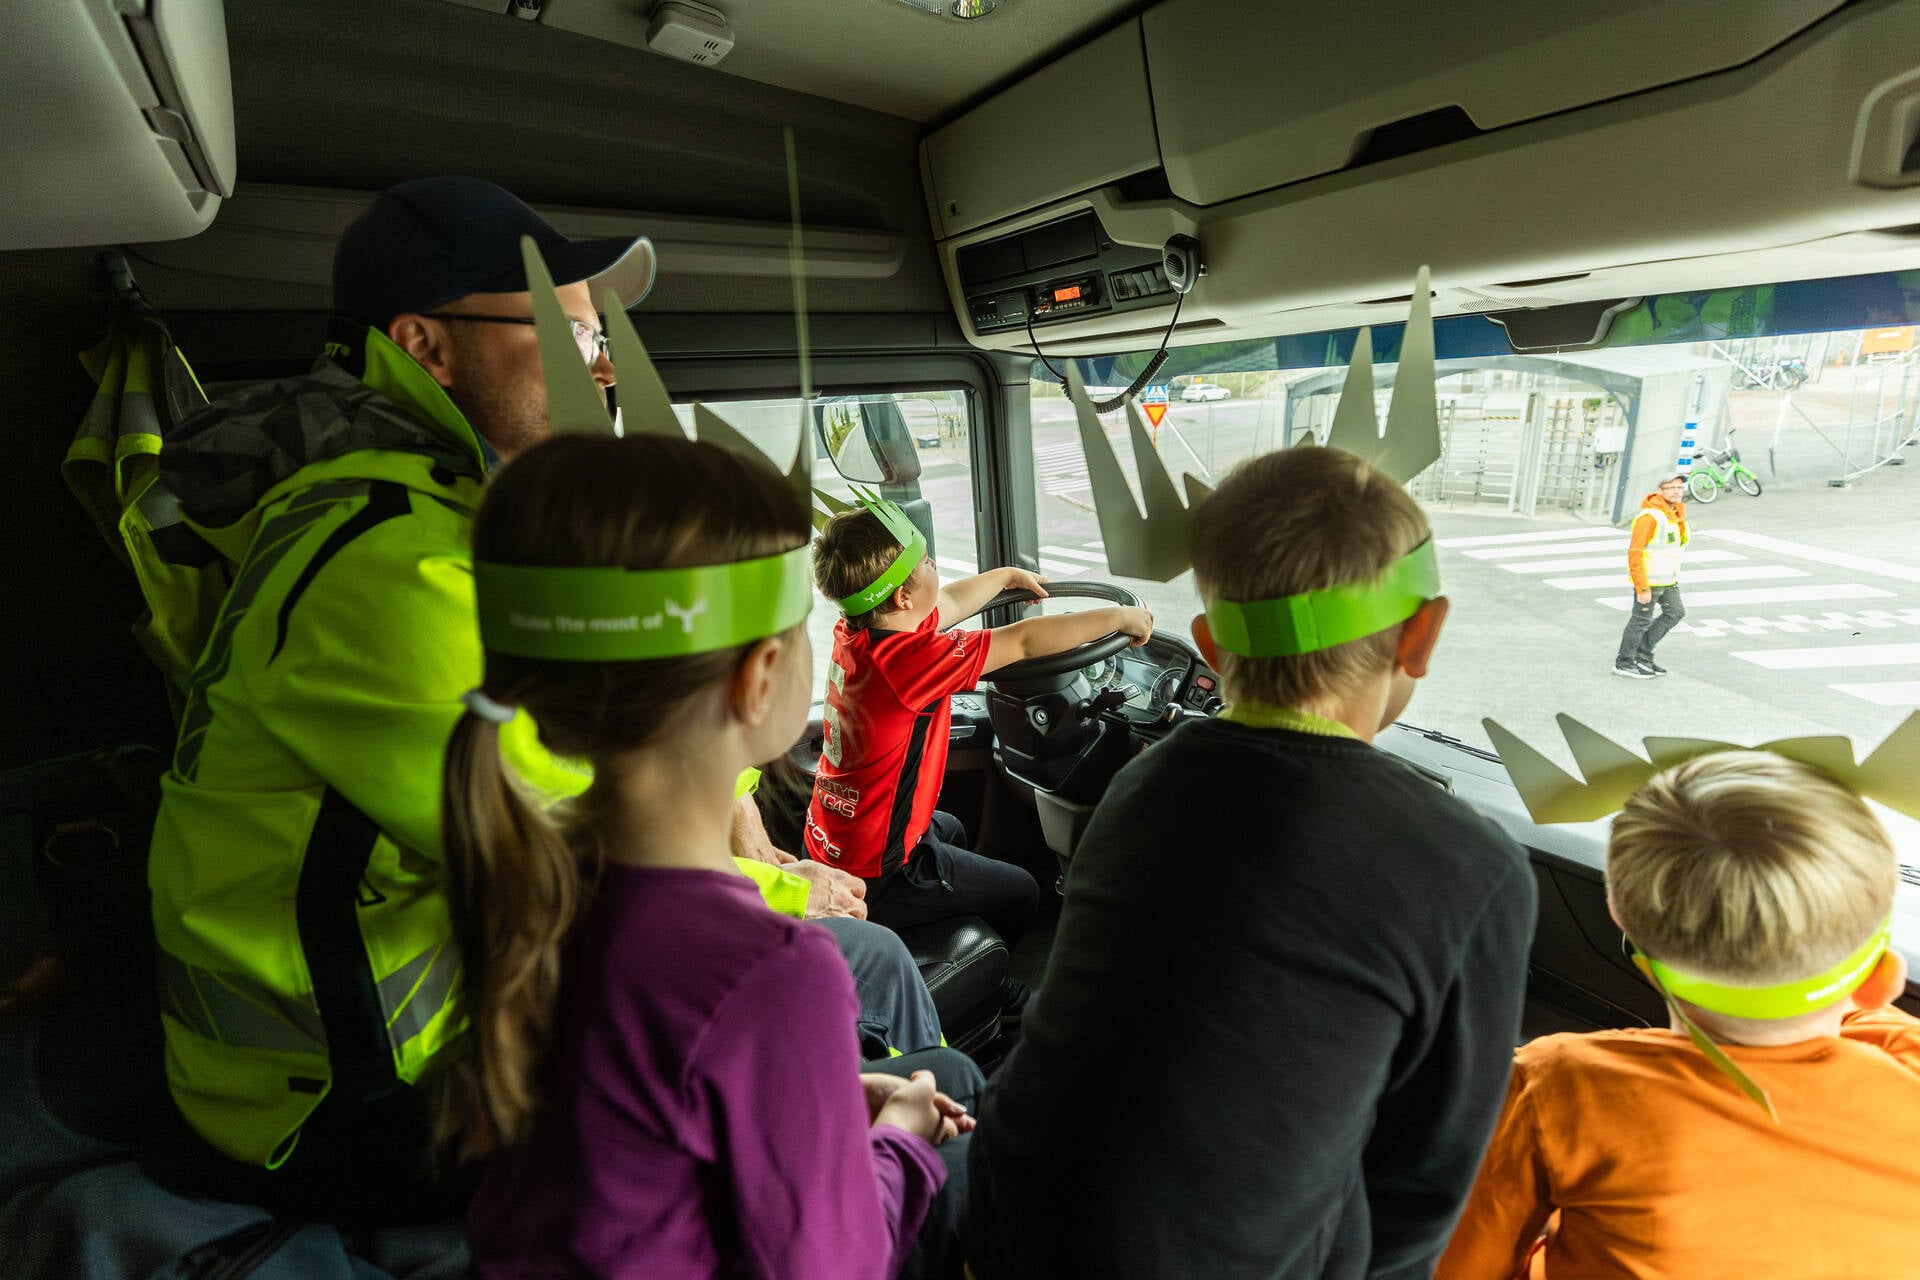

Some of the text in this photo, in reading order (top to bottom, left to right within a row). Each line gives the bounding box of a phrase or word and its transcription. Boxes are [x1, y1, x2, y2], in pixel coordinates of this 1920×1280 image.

[555, 614, 586, 632] the
[589, 614, 639, 632] most
[641, 611, 664, 631] of
